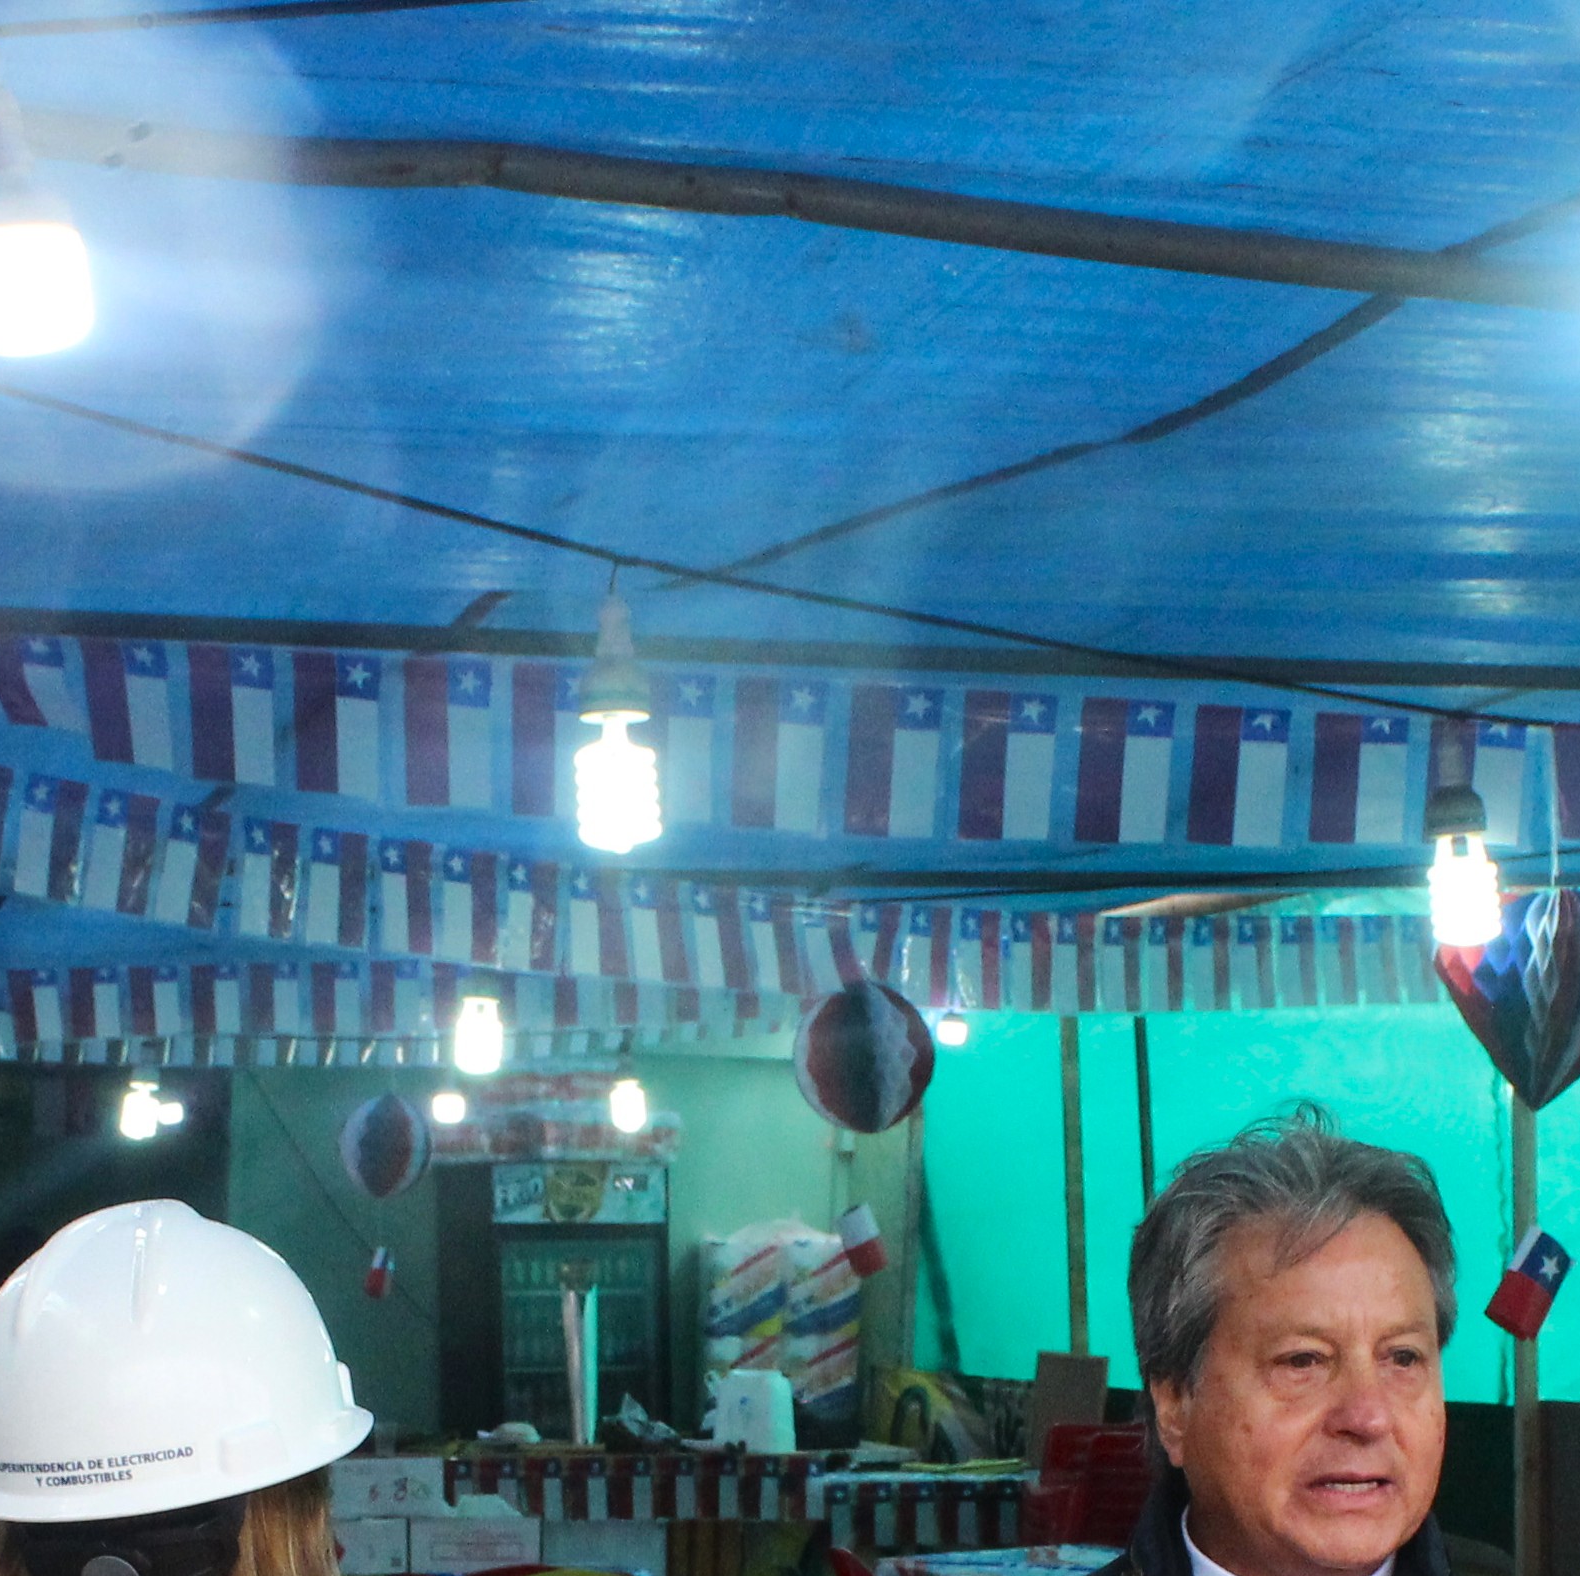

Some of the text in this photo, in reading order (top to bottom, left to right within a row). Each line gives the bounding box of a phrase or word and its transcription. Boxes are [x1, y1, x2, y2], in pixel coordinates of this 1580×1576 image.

[88, 1459, 104, 1470] DE
[107, 1446, 194, 1468] ELECTRICIDAD
[35, 1470, 133, 1488] Y COMBUSTIBLES
